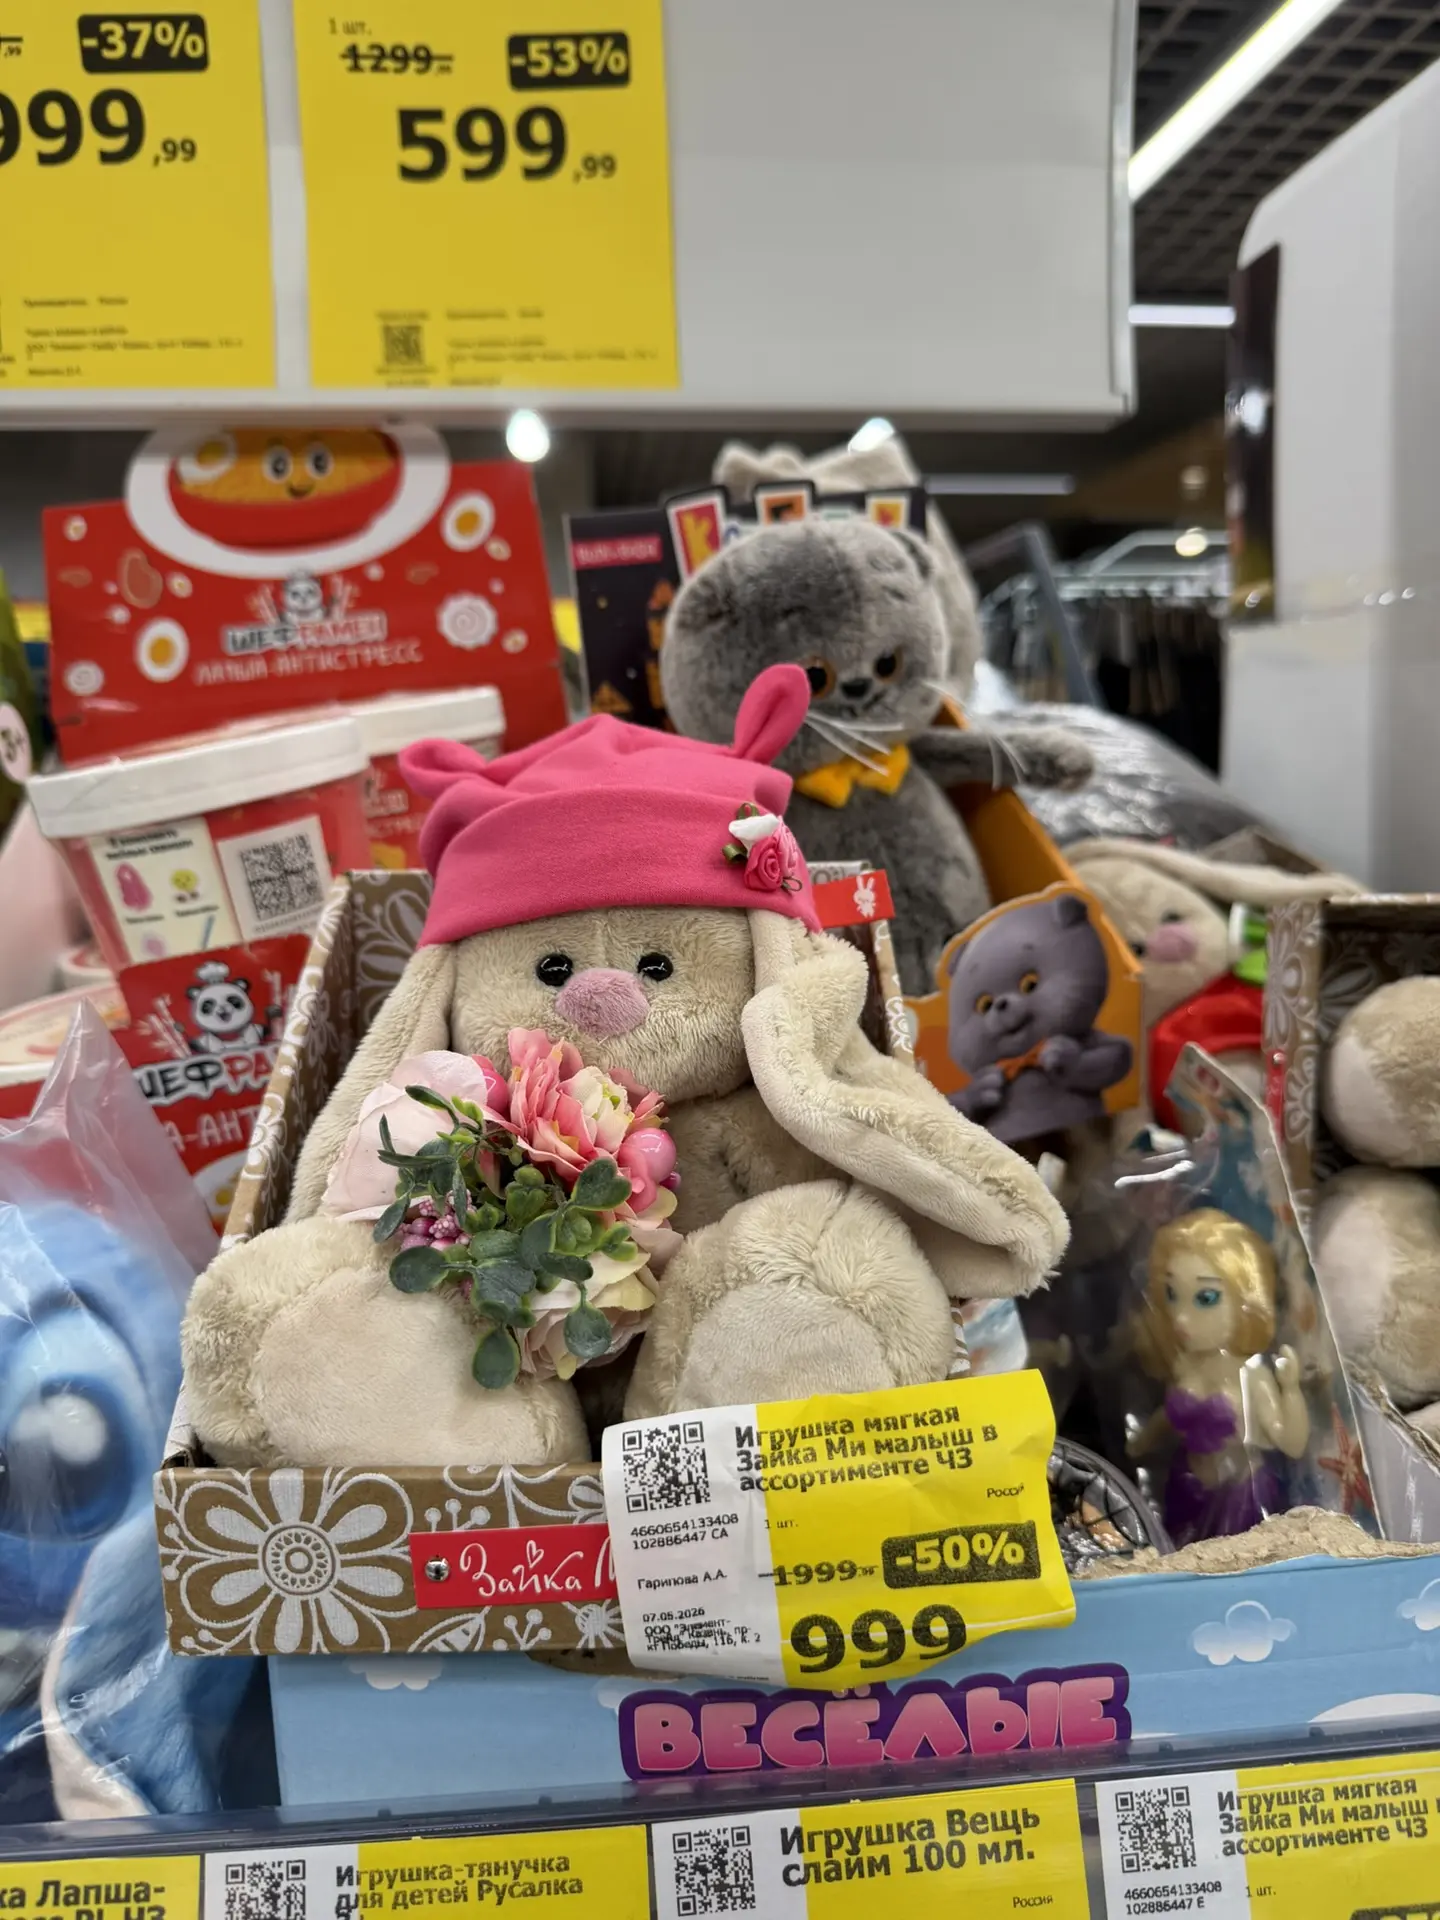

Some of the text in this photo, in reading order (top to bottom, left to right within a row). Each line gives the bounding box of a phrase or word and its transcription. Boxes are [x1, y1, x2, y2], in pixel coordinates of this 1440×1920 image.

[82, 21, 205, 60] -37%
[510, 38, 628, 77] -53%
[735, 1406, 960, 1450] Игрушка мягкая
[736, 1424, 999, 1472] Зайка Ми малыш в
[740, 1459, 930, 1492] ассортименте
[630, 1513, 739, 1537] 4660654133408
[459, 1541, 584, 1598] Зайка
[895, 1531, 1025, 1573] -50%
[638, 1574, 699, 1590] Гарипова
[790, 1603, 967, 1673] 999
[633, 1675, 1117, 1771] ВЕСЁЛЫЕ
[1217, 1778, 1417, 1813] Игрушка мягкая
[780, 1808, 1040, 1858] Игрушка Вещь
[1218, 1808, 1292, 1834] Зайка
[1299, 1804, 1335, 1827] Ми
[1342, 1796, 1429, 1820] малыш
[1222, 1823, 1390, 1856] ассортименте
[336, 1855, 571, 1890] Игрушка-тянучка
[782, 1839, 1035, 1887] слайм 100 мл.
[36, 1879, 165, 1907] Лапша-
[335, 1892, 384, 1914] для
[391, 1879, 469, 1910] детей
[477, 1877, 584, 1906] Русалка
[1012, 1894, 1053, 1908] Россия
[1124, 1880, 1222, 1901] 4660654133408
